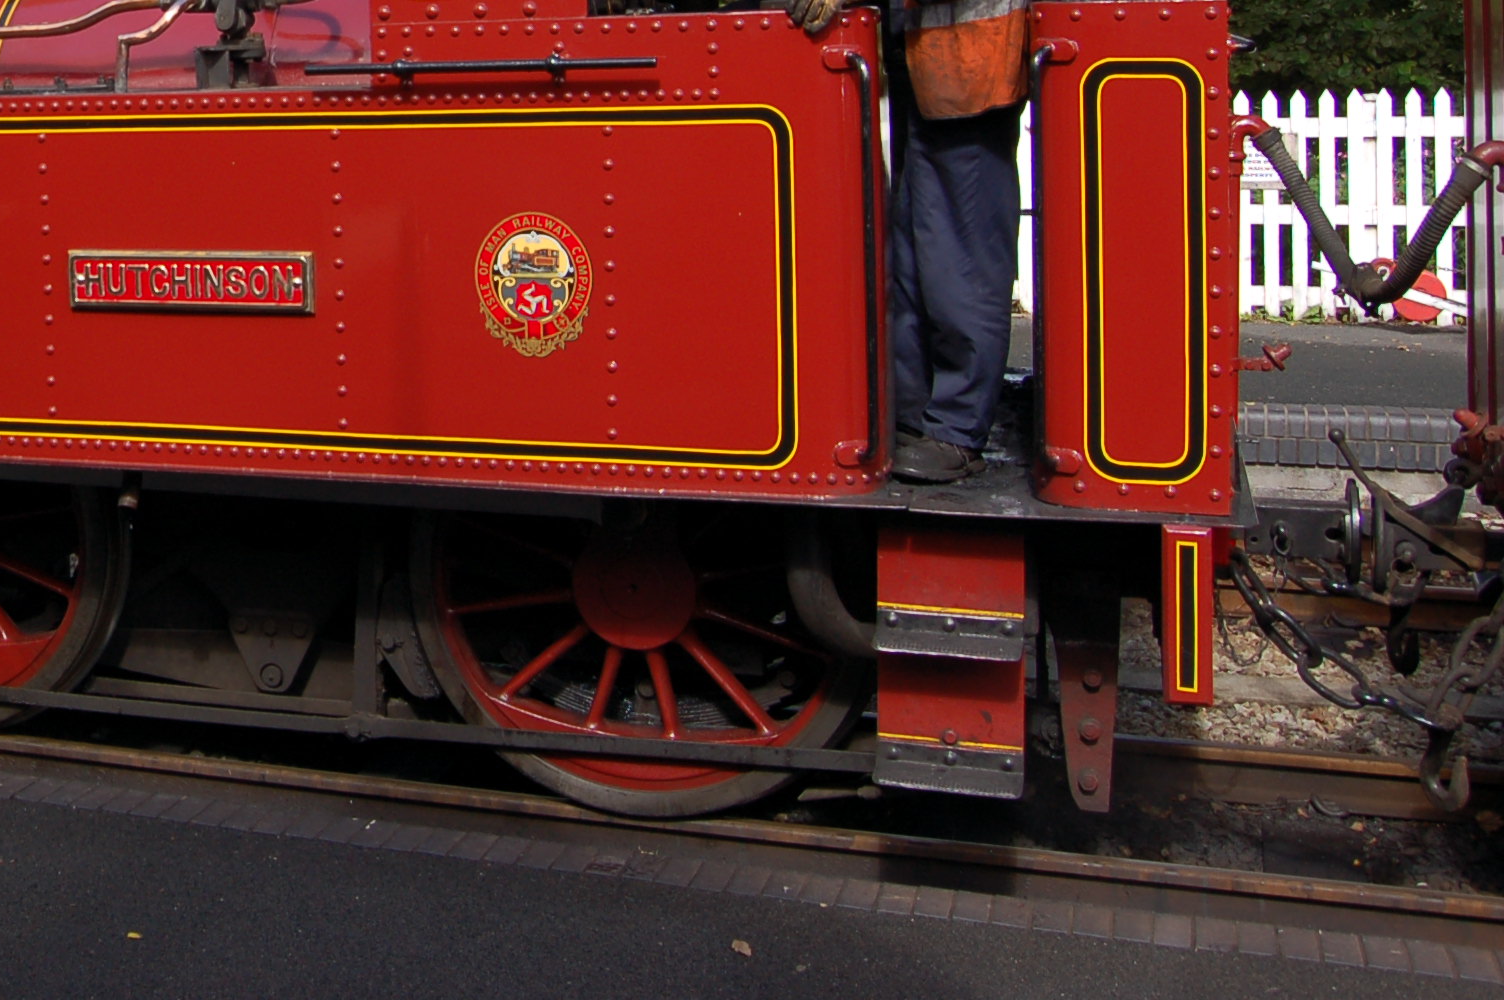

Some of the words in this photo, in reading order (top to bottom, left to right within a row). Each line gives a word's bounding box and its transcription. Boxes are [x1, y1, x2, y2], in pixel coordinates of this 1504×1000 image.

[512, 215, 571, 240] RAILWAY
[484, 228, 507, 253] MAN
[479, 259, 489, 276] OF
[84, 262, 295, 300] HUTCHINSON
[479, 283, 499, 311] ISLE
